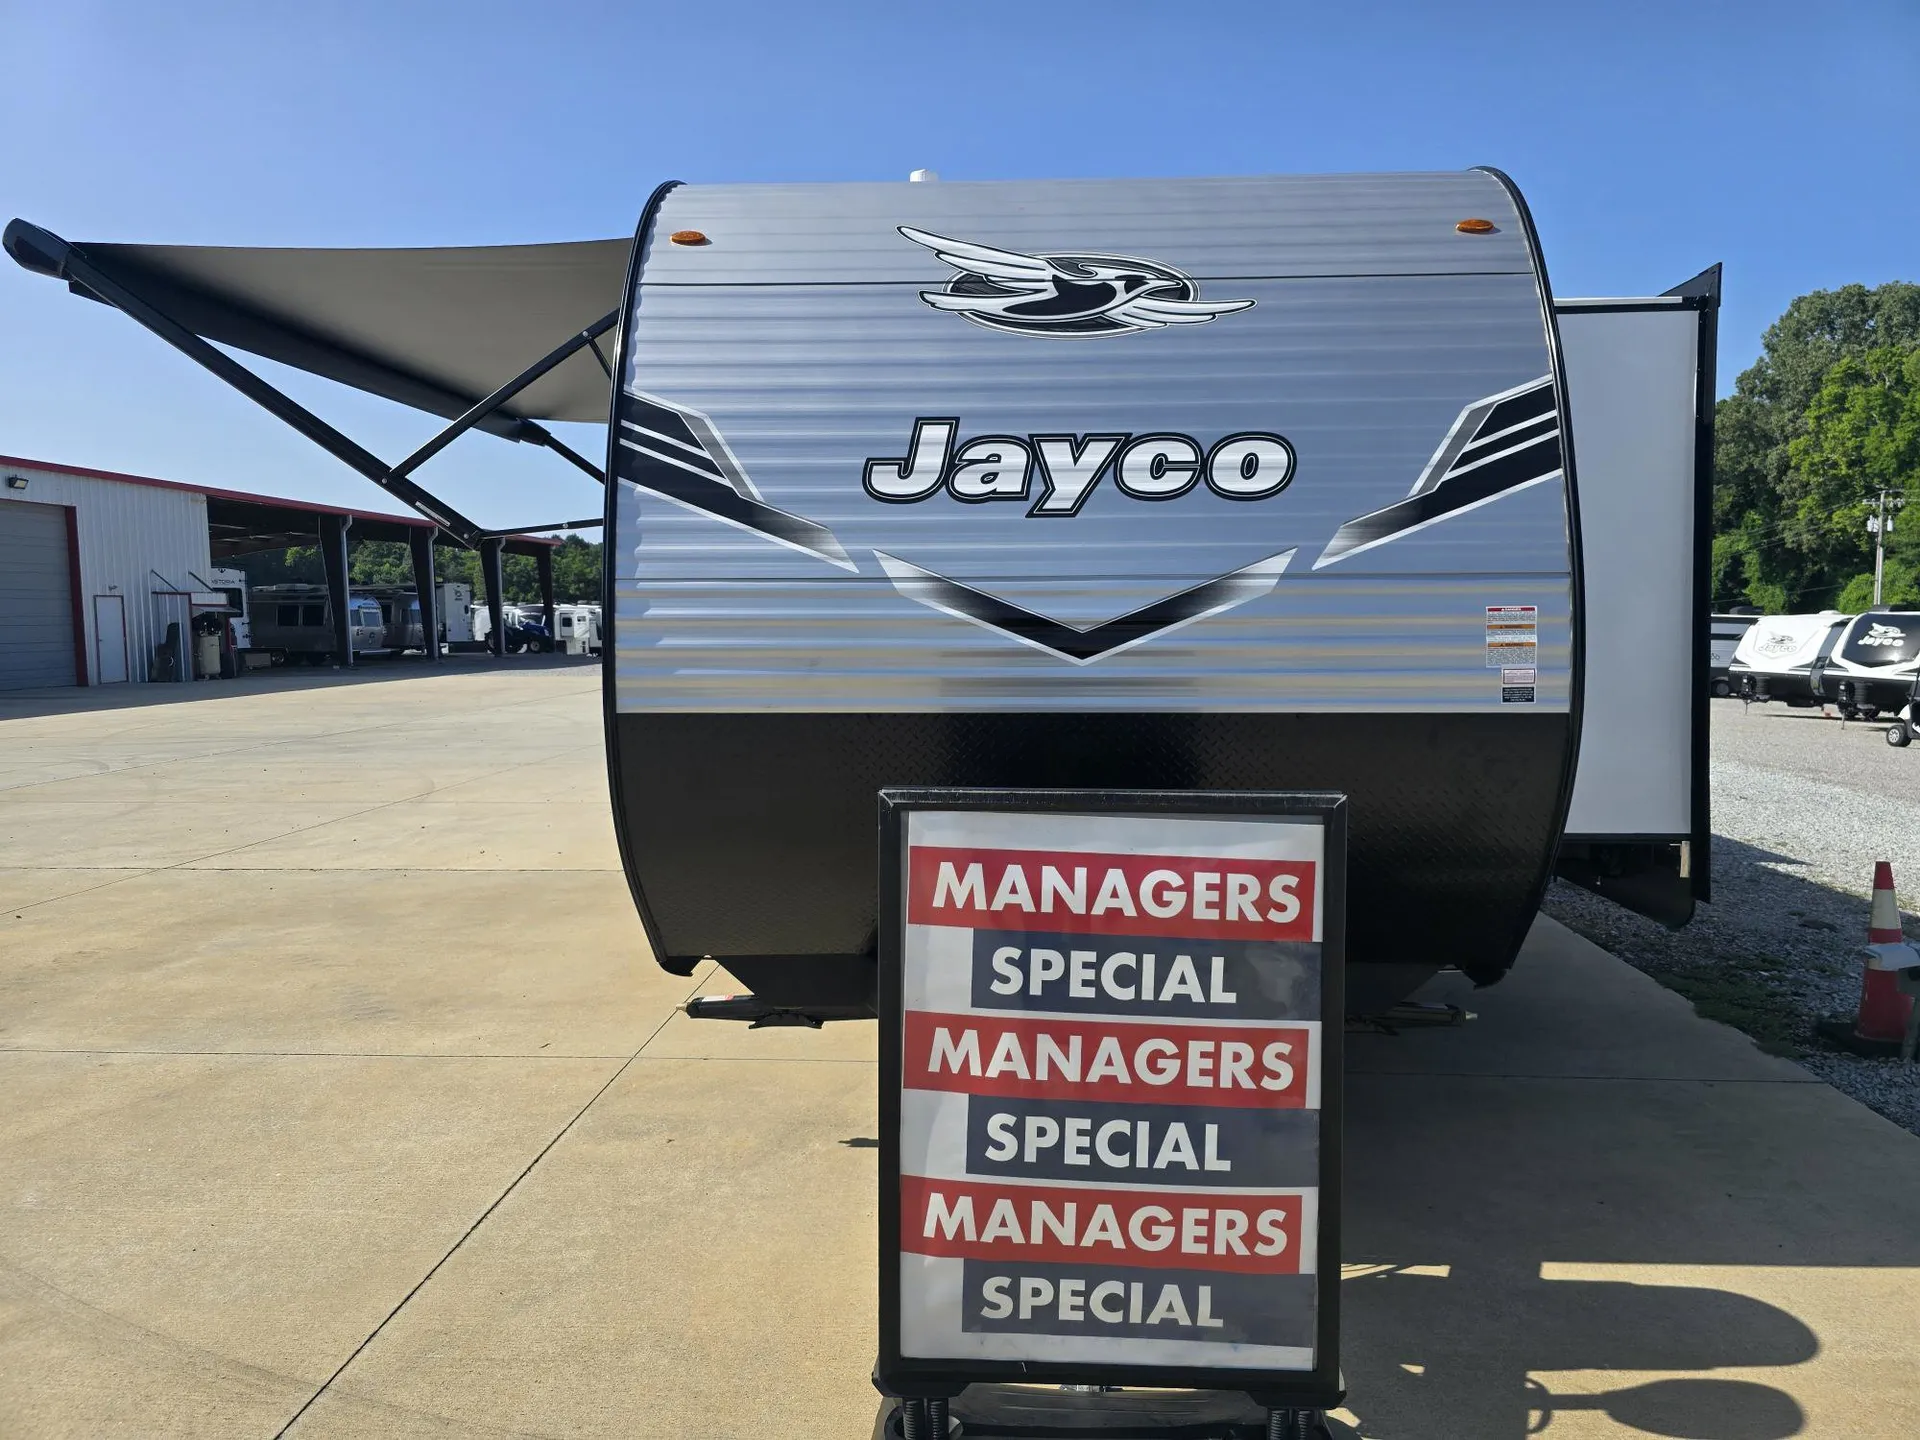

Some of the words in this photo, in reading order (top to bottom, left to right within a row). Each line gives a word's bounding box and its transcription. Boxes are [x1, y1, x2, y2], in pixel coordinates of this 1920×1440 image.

[861, 416, 1297, 518] Jayco
[1857, 635, 1904, 647] Jayco
[932, 861, 1301, 924] MANAGERS
[989, 946, 1237, 1004] SPECIAL
[927, 1027, 1294, 1091] MANAGERS
[984, 1113, 1232, 1172] SPECIAL
[922, 1192, 1288, 1257] MANAGERS
[979, 1276, 1224, 1328] SPECIAL
